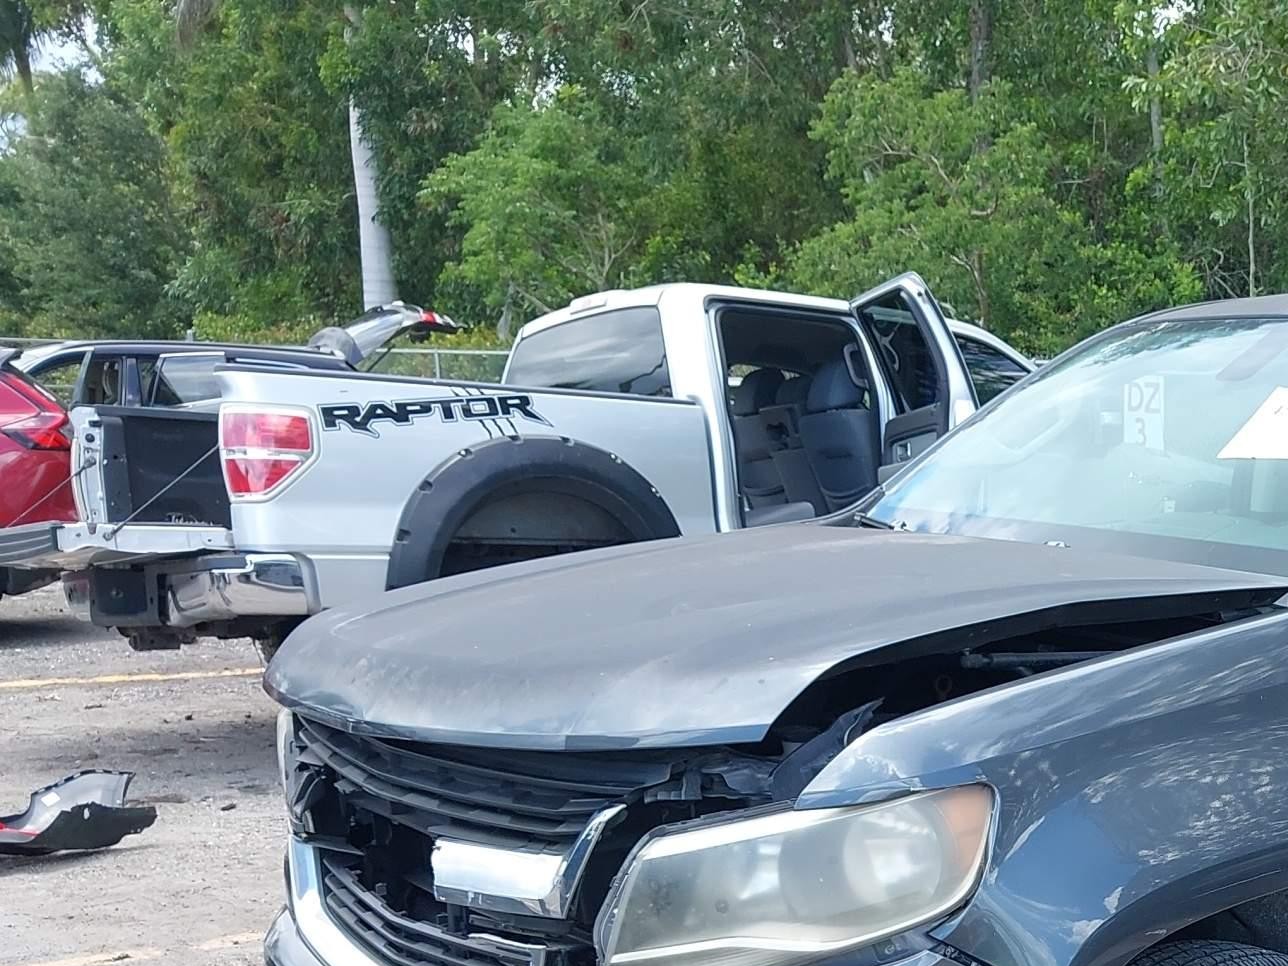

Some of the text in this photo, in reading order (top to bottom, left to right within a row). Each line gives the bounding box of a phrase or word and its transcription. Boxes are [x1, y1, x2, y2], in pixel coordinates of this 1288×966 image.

[1128, 381, 1161, 414] DZ
[317, 393, 554, 438] RAPTOR
[1134, 417, 1147, 445] 3
